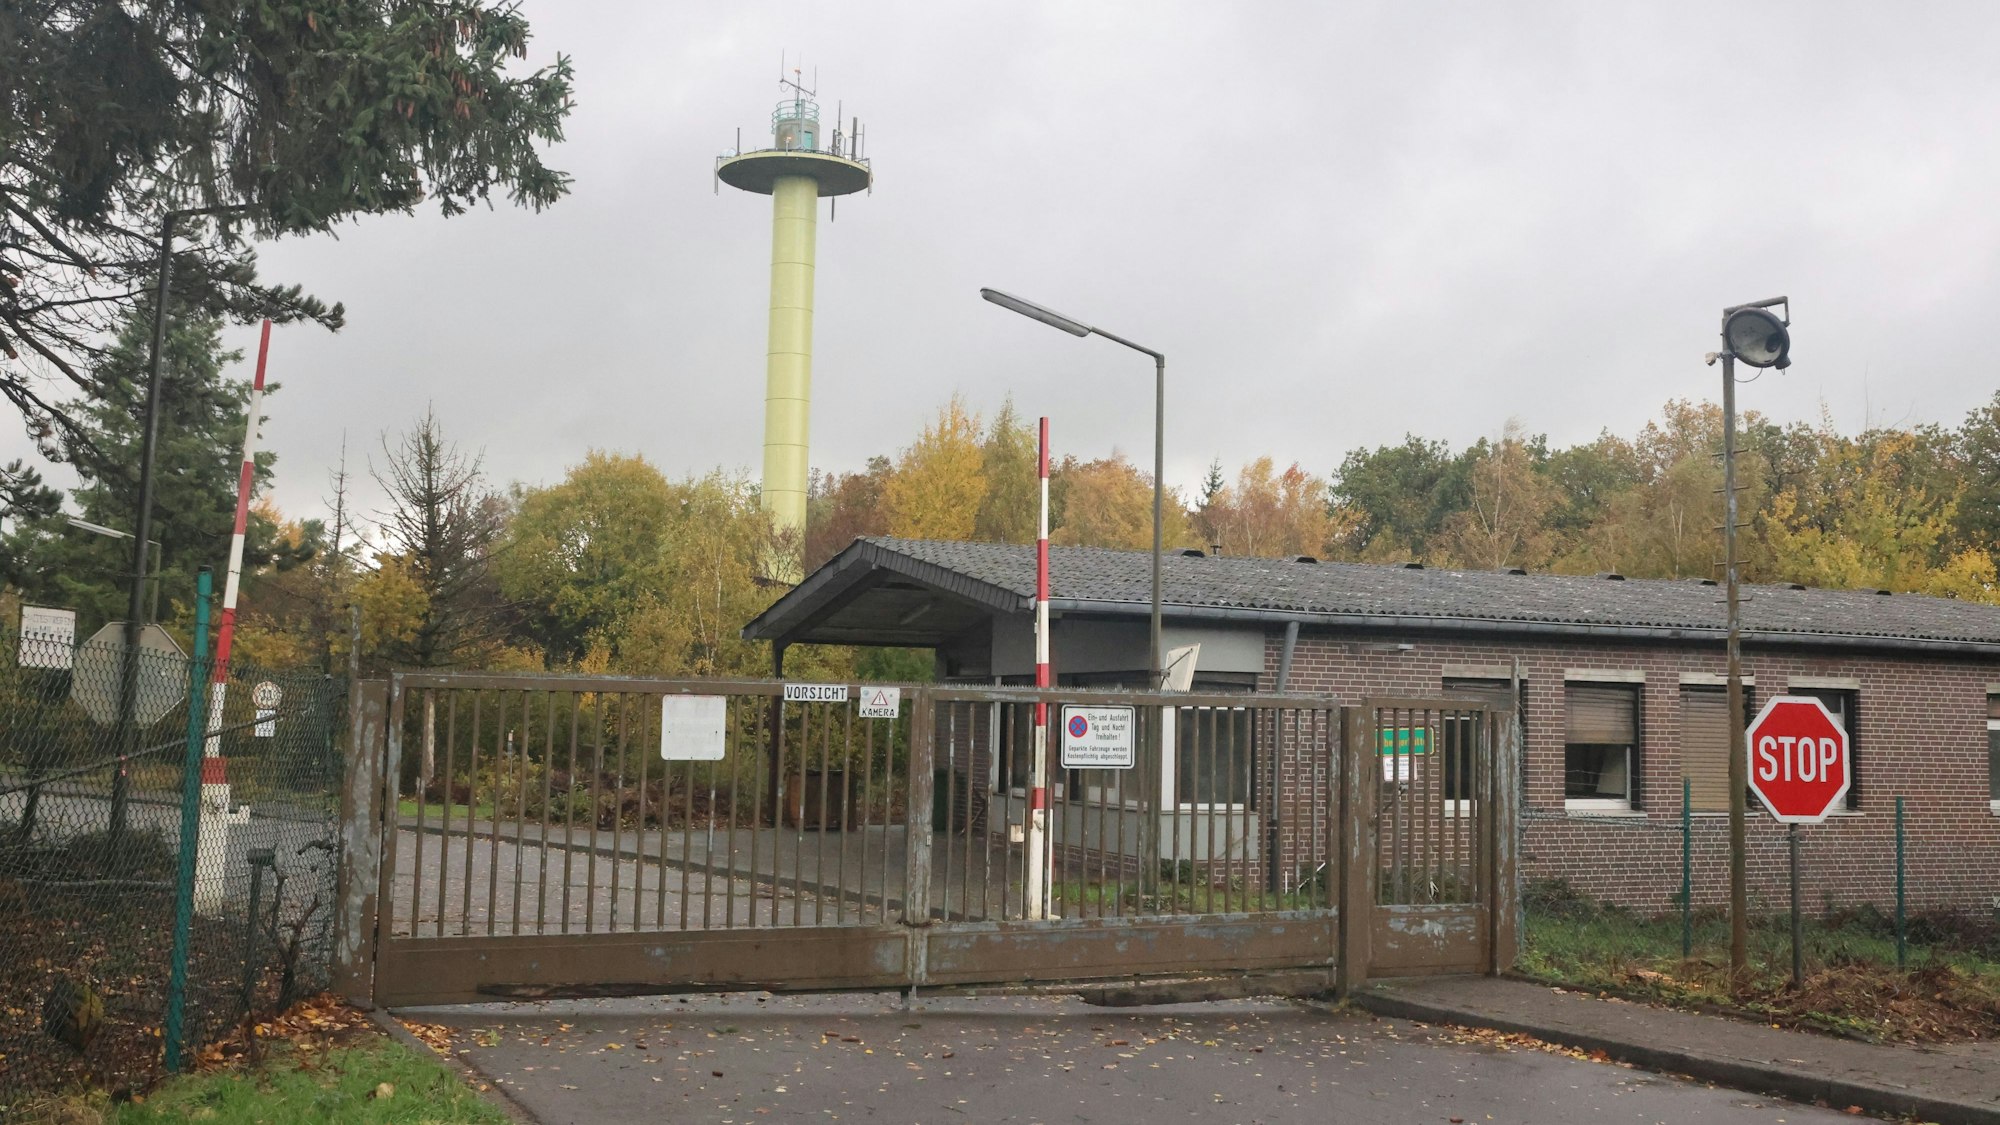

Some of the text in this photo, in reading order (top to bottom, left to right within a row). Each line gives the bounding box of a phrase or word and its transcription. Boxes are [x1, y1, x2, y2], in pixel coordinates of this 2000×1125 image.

[786, 686, 846, 700] VORSICHT
[862, 708, 895, 717] KAMERA
[1091, 723, 1100, 732] Tag
[1112, 723, 1125, 731] Nacht
[1089, 745, 1110, 753] Fahrzeuge
[1759, 736, 1837, 782] STOP
